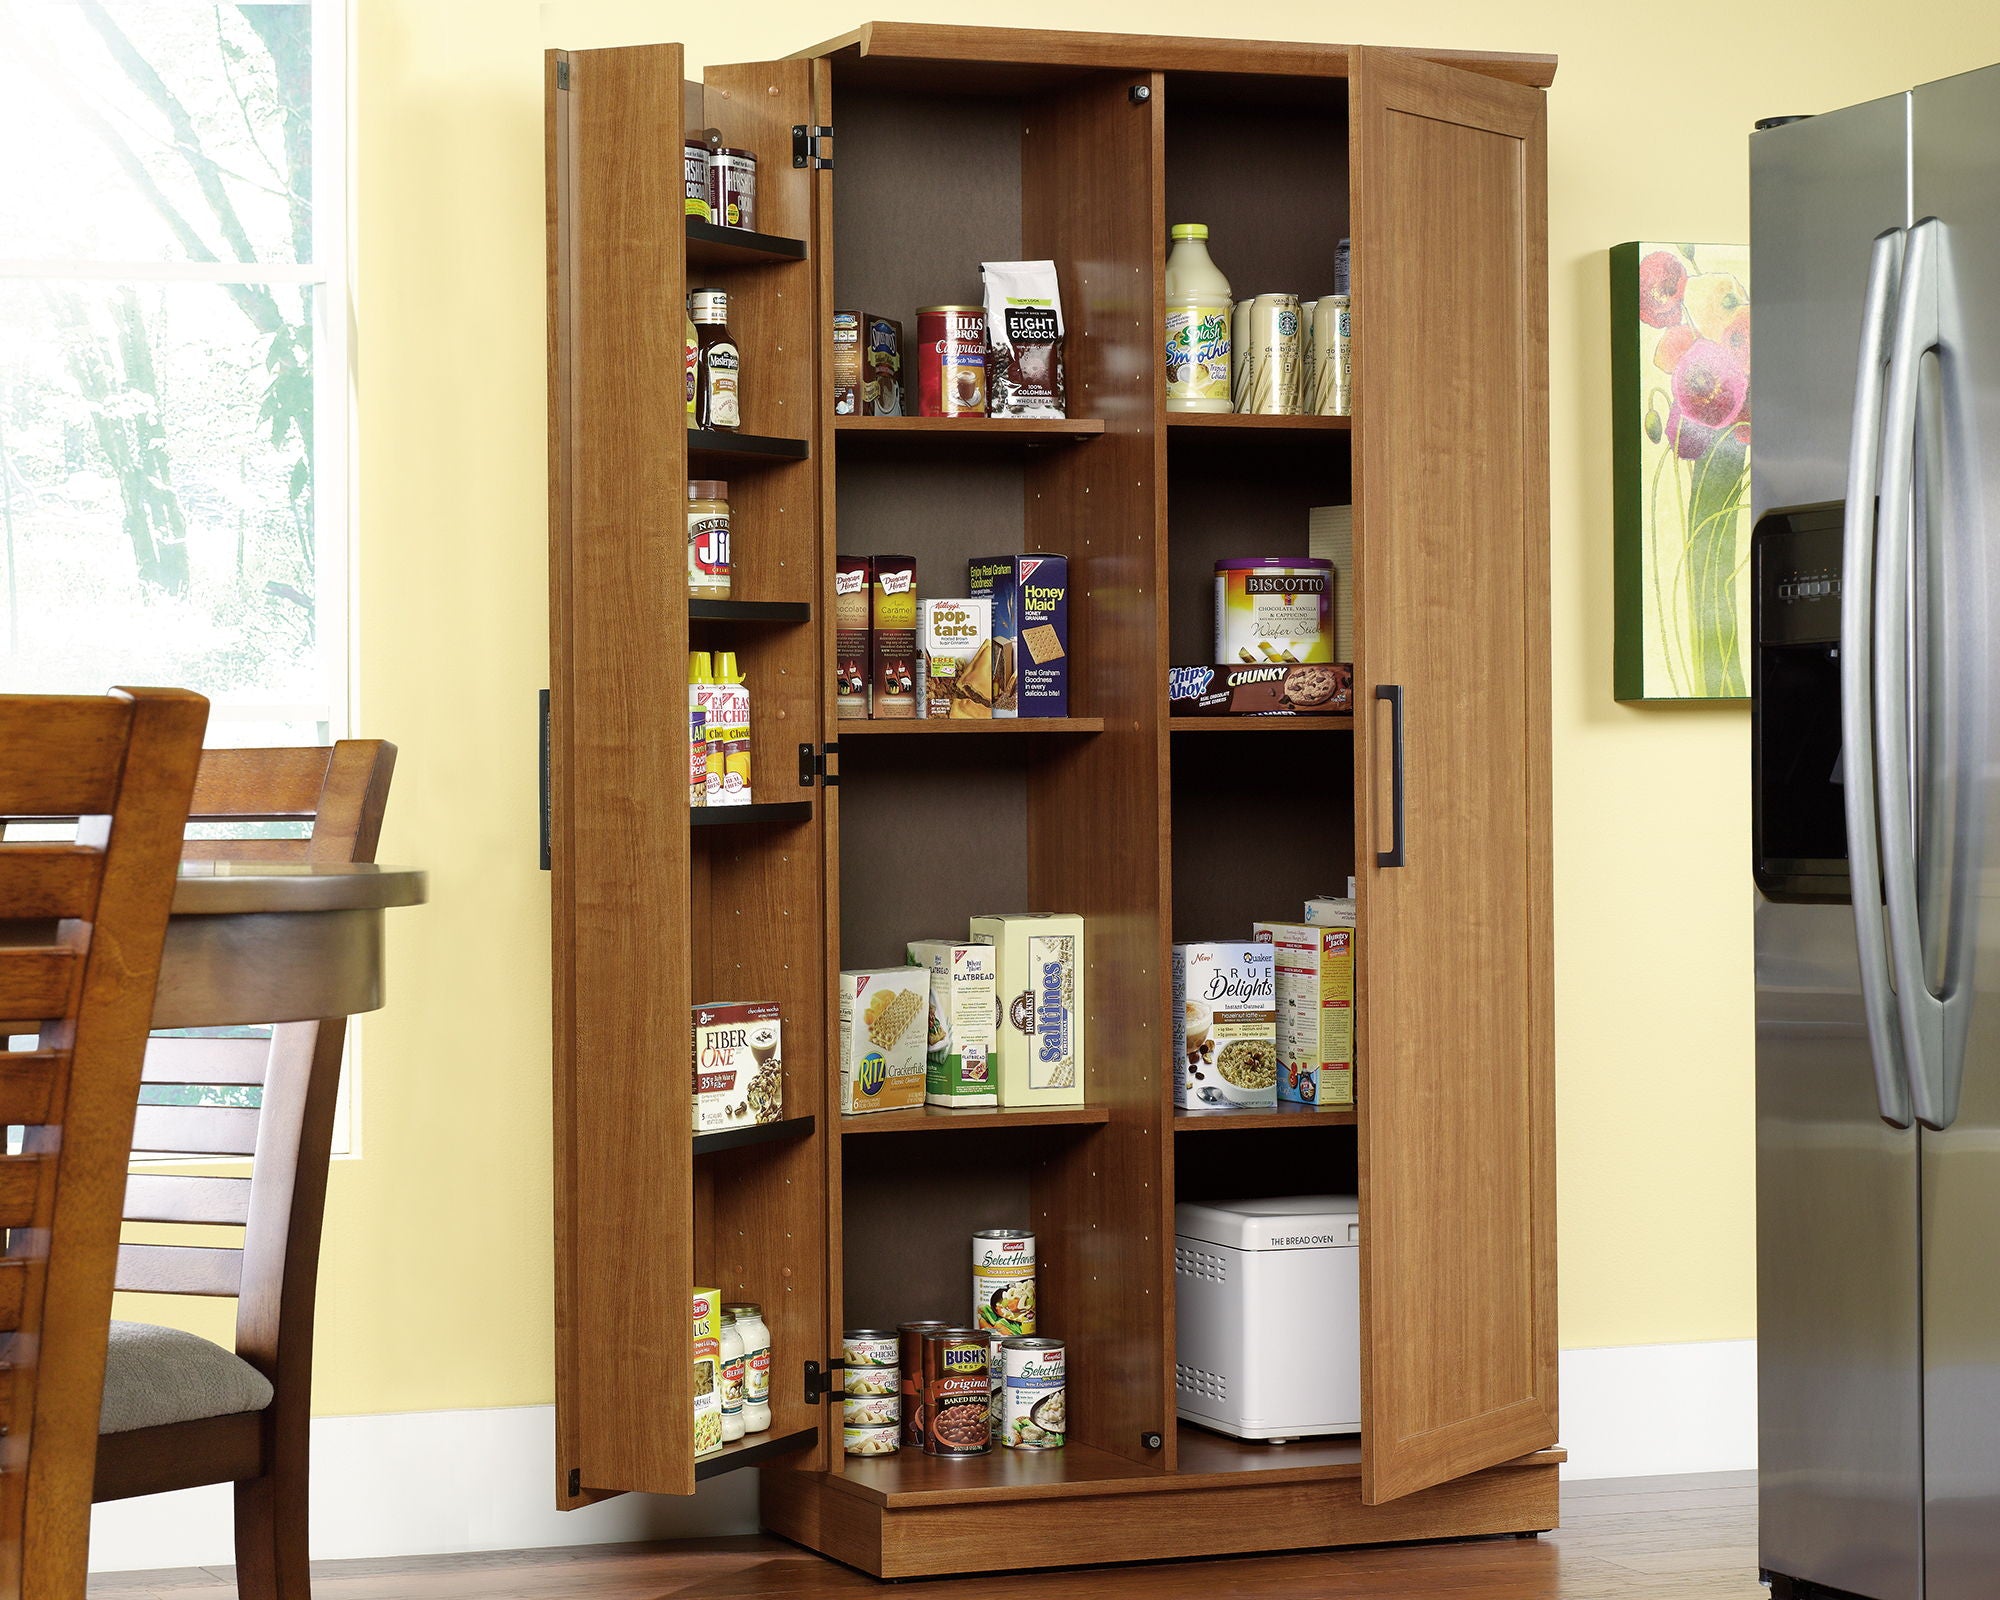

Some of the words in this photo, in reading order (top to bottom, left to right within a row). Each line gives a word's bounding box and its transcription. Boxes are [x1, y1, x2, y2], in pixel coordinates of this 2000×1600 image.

[1010, 317, 1055, 330] EIGHT
[1011, 330, 1056, 339] O'CLOCK
[982, 565, 993, 576] Real
[992, 564, 1012, 576] Graham
[884, 575, 908, 584] Duncan
[1248, 578, 1324, 592] BISCOTTO
[888, 582, 907, 591] Hines
[1024, 585, 1065, 601] Honey
[881, 605, 912, 614] Caramel
[935, 601, 960, 611] Kellogg's
[1025, 598, 1056, 611] Maid
[934, 624, 978, 637] tarts
[1251, 621, 1291, 639] Wafer
[1227, 667, 1288, 687] CHUNKY
[1325, 933, 1348, 943] Hungry
[1329, 939, 1344, 949] Jack
[1191, 953, 1213, 965] New!
[1243, 952, 1273, 964] Quaker
[953, 973, 995, 981] FLATBREAD
[1213, 968, 1272, 978] TRUE
[1203, 975, 1273, 1003] Delights
[748, 1007, 766, 1015] chocolate
[766, 1005, 779, 1013] mocha
[1038, 962, 1062, 1062] Saltines
[706, 1029, 748, 1050] FIBER
[701, 1046, 735, 1068] ONE
[859, 1057, 885, 1090] RITZ
[888, 1059, 924, 1077] Crackerfuls
[713, 1081, 727, 1089] Fiber
[853, 1097, 859, 1109] 6
[1271, 1237, 1284, 1246] THE
[1285, 1236, 1311, 1246] BREAD
[1311, 1235, 1334, 1244] OVEN
[981, 1250, 1012, 1269] Select
[869, 1350, 897, 1359] CHICKEN
[946, 1348, 987, 1366] BUSH'S
[1020, 1361, 1050, 1379] Select
[944, 1378, 988, 1391] Original
[944, 1396, 969, 1405] BAKED
